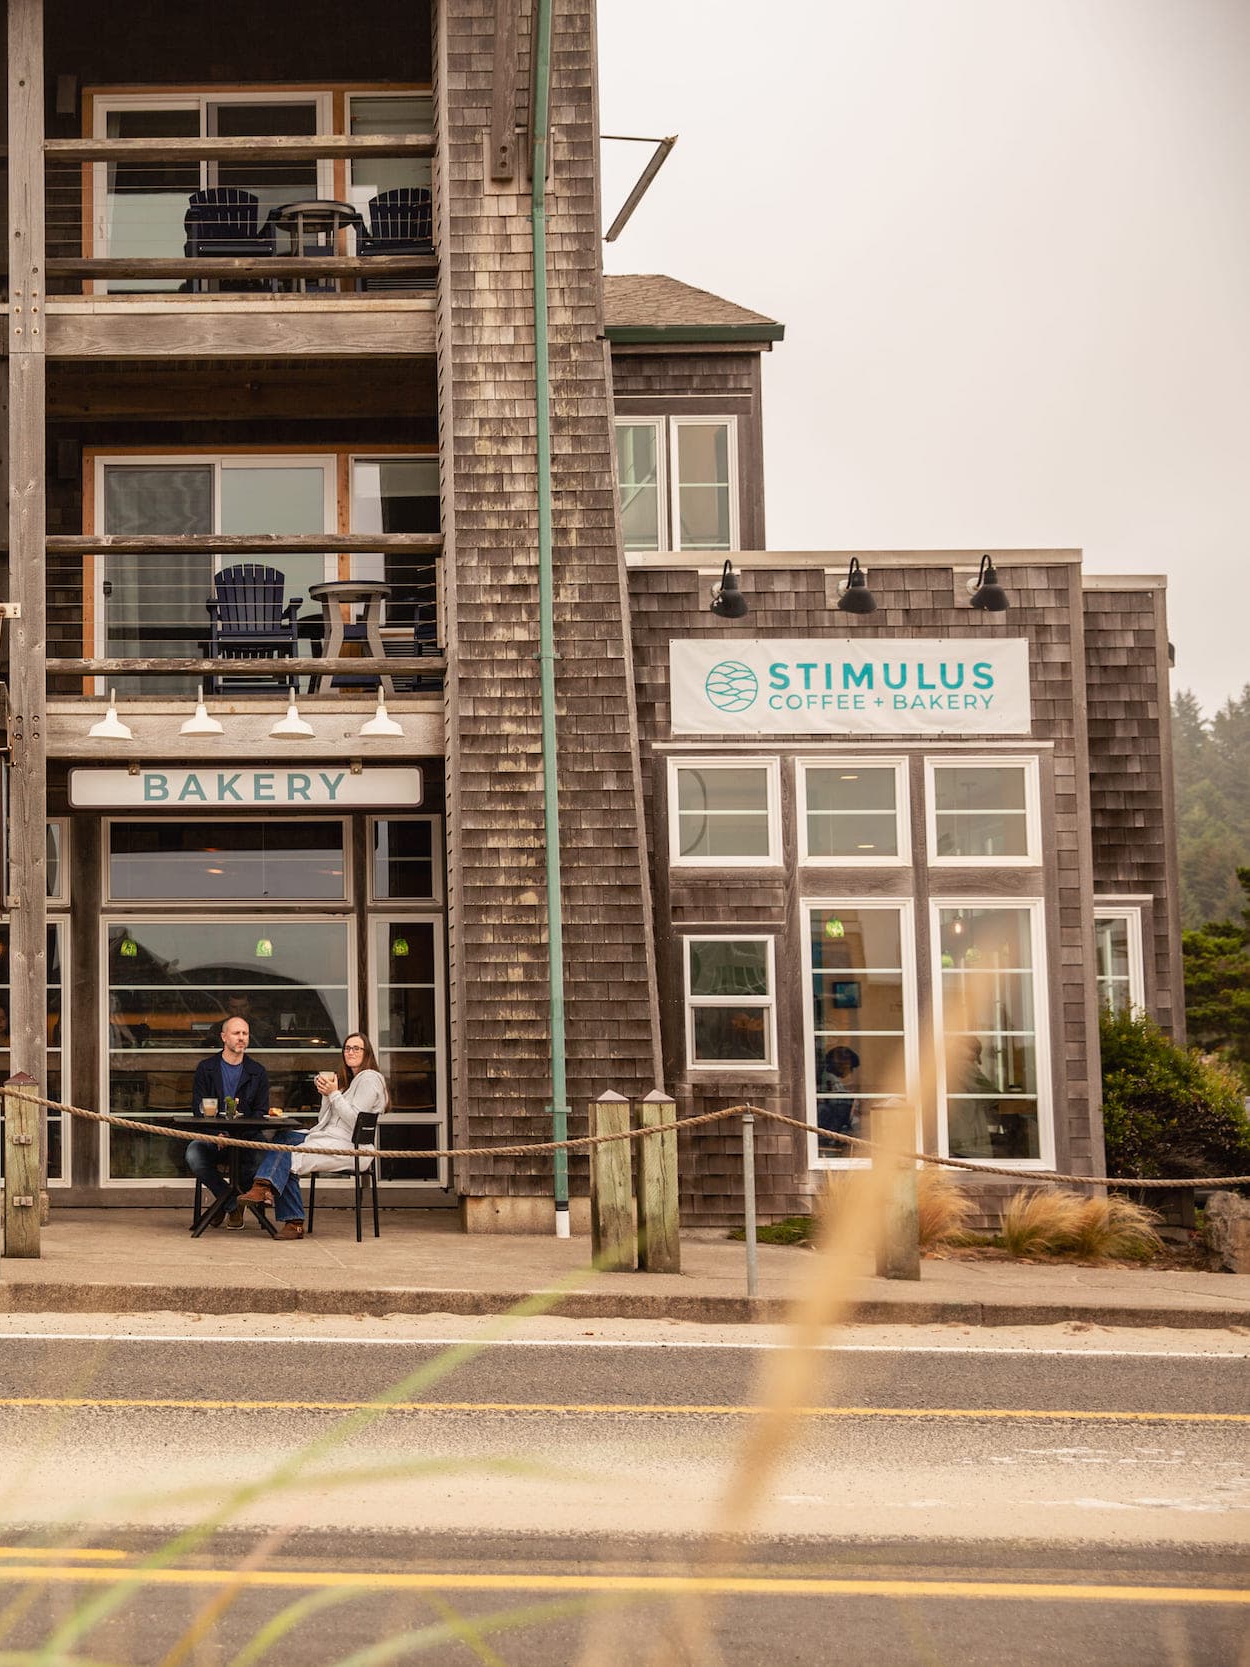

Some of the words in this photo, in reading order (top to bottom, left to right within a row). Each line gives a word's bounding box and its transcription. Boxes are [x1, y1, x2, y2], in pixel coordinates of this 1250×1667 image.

[768, 662, 994, 690] STIMULUS
[768, 694, 866, 710] COFFEE
[873, 697, 884, 708] +
[893, 694, 994, 710] BAKERY
[143, 773, 346, 801] BAKERY
